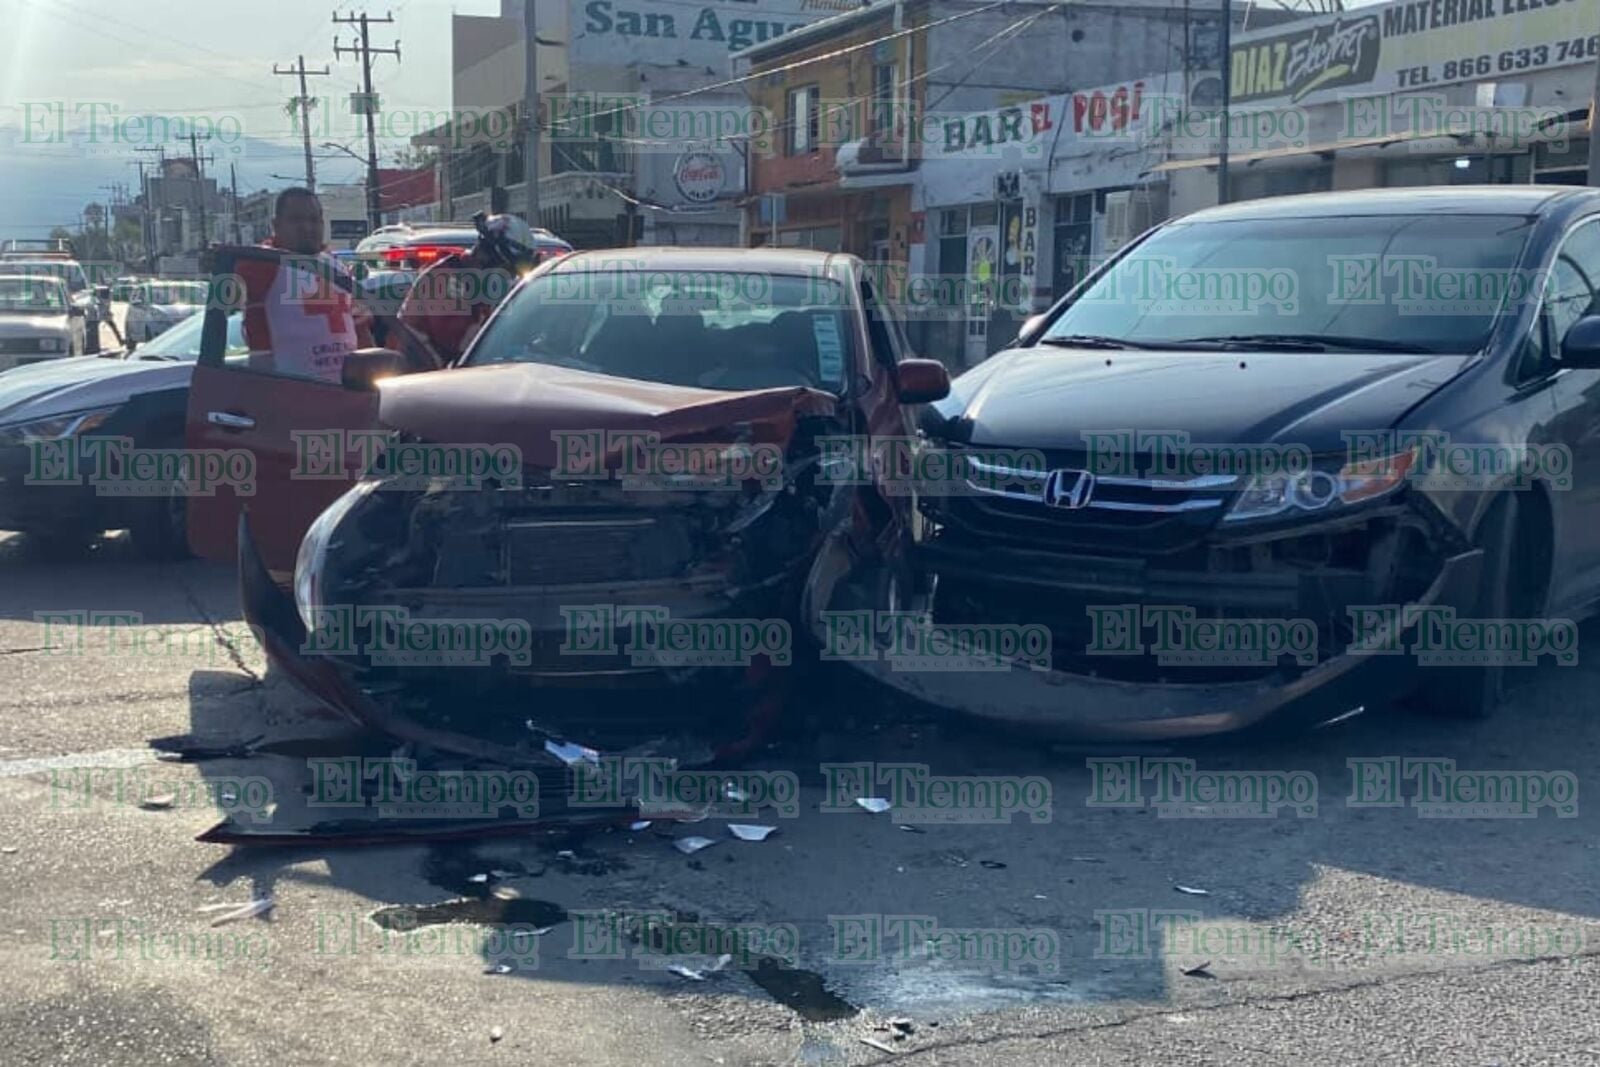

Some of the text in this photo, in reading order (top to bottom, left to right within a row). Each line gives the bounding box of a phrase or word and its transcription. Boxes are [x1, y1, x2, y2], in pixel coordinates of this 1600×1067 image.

[585, 0, 677, 38] San
[1384, 0, 1495, 38] MATERIAL
[1232, 42, 1288, 97] DIAZ
[1397, 66, 1437, 87] TEL.
[1443, 55, 1491, 80] 866
[1498, 45, 1549, 72] 633
[944, 108, 1022, 153] BAR
[1024, 206, 1037, 277] BAR
